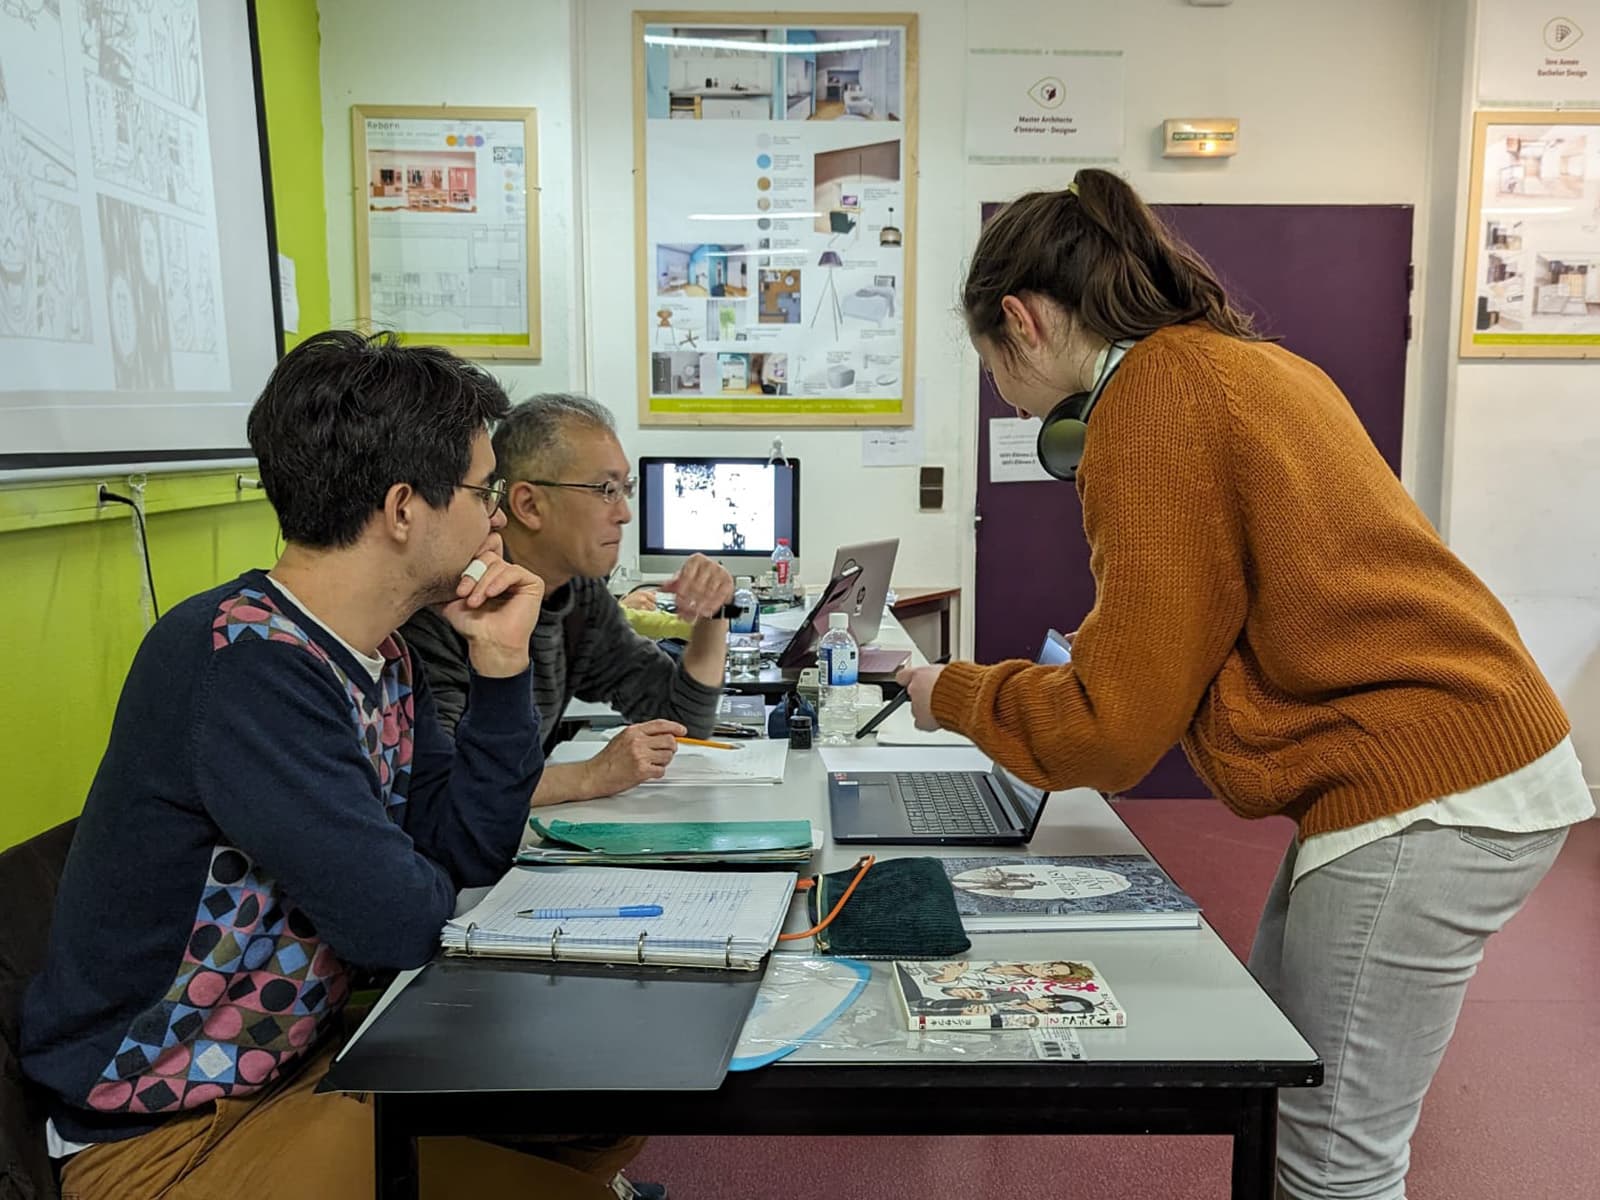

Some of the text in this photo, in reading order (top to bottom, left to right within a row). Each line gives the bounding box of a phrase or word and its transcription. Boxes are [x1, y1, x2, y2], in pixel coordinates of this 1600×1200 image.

[1566, 69, 1588, 78] Design
[1041, 115, 1073, 123] Architecte
[1050, 126, 1078, 136] Designer
